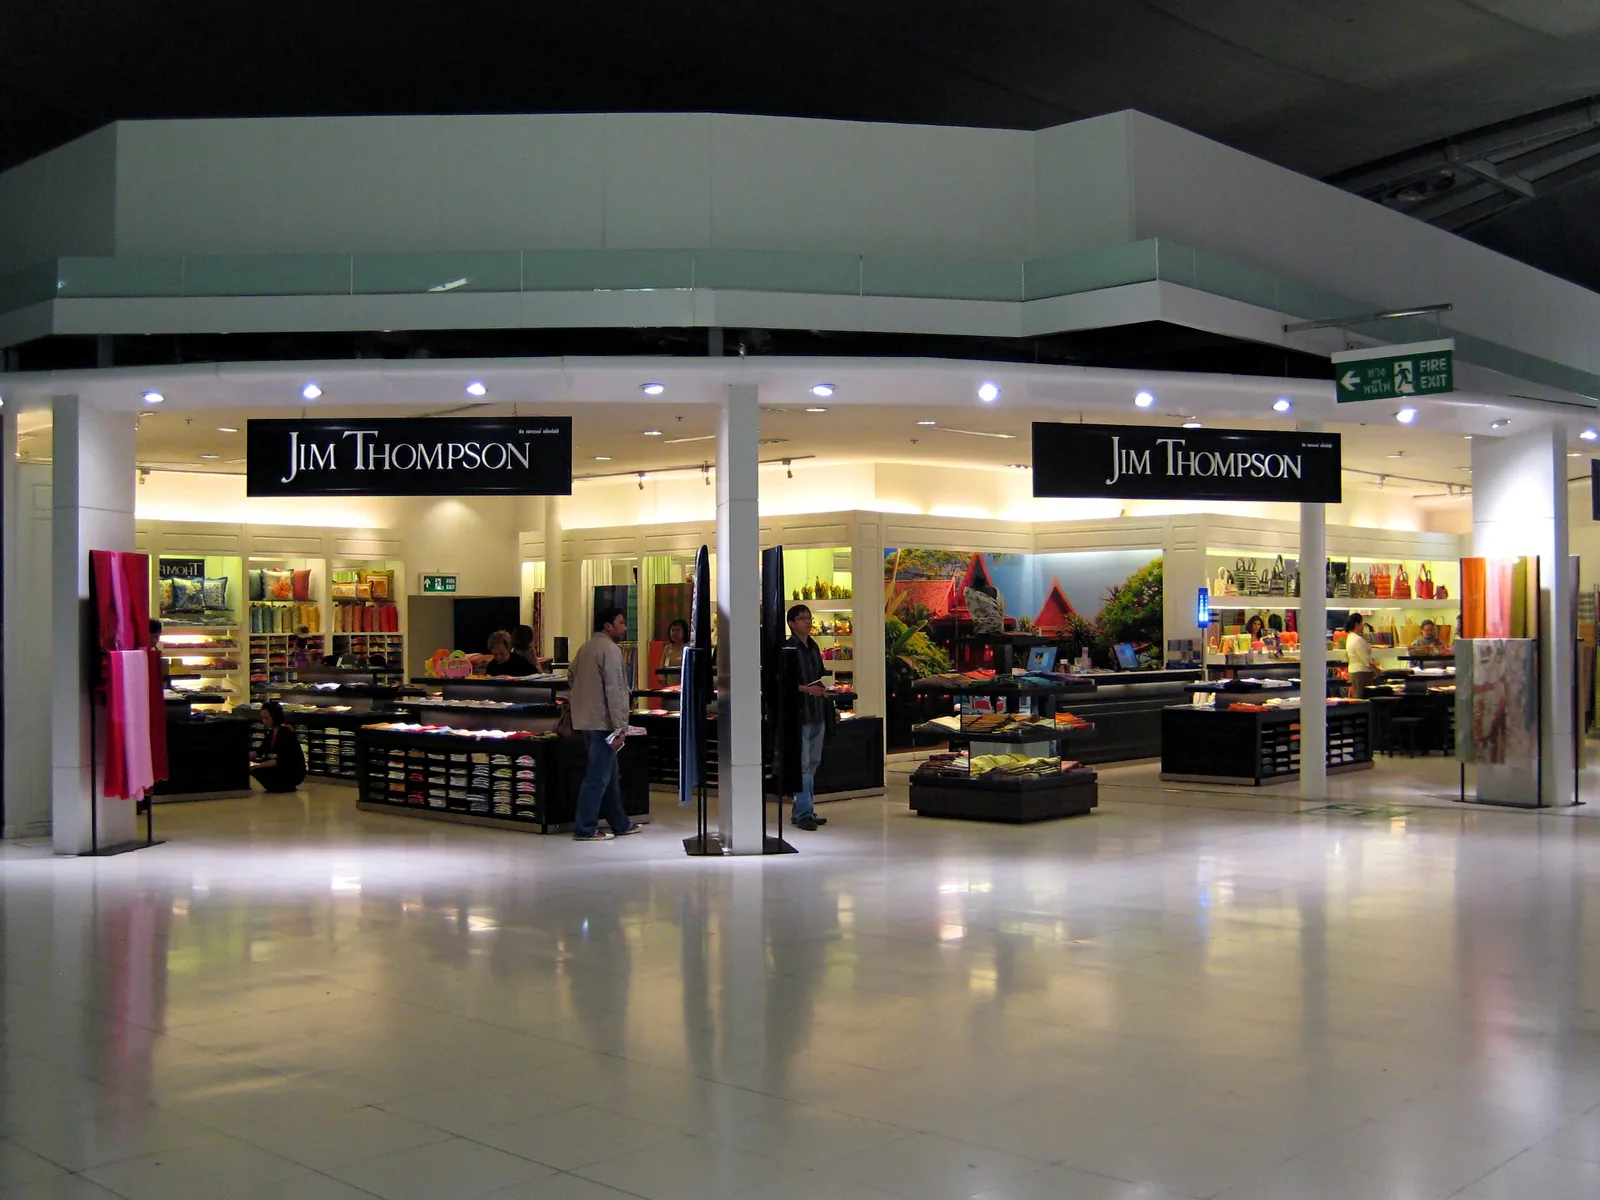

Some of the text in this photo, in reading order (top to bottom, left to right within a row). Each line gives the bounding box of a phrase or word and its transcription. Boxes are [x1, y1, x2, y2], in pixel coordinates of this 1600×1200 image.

[1367, 367, 1386, 378] ทาง
[1420, 358, 1447, 373] FIRE
[1420, 375, 1447, 388] EXIT
[280, 430, 530, 483] JIM THOMPSON
[1105, 436, 1302, 485] JIM THOMPSON
